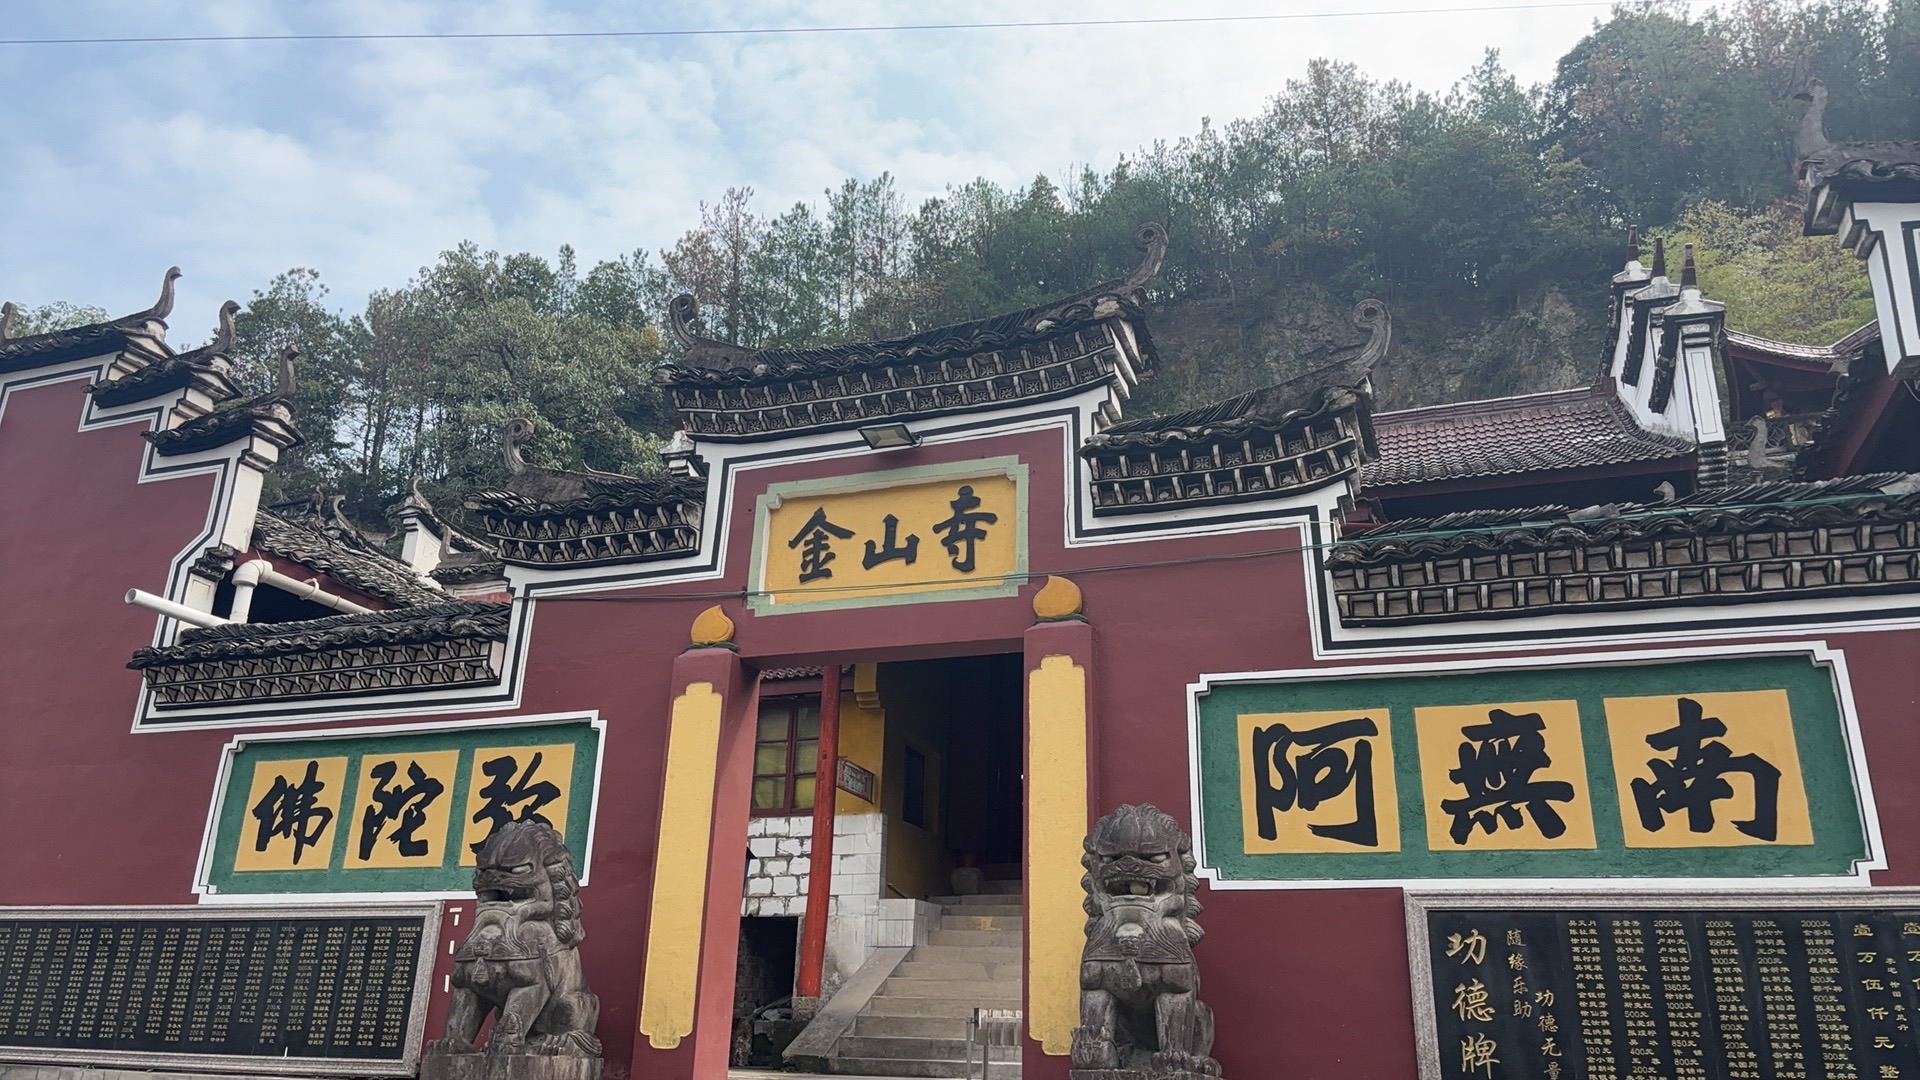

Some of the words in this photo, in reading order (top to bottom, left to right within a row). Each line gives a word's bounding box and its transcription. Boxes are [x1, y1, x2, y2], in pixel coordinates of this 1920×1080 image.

[788, 485, 998, 584] 金山寺
[1751, 920, 1777, 928] 300元
[1616, 955, 1642, 963] 680元
[1710, 957, 1739, 965] 1000元
[1757, 957, 1783, 965] 200元
[1506, 928, 1533, 1020] 随缘乐助
[1618, 973, 1644, 981] 600元
[1809, 976, 1836, 984] 800元
[1716, 995, 1742, 1003] 800元
[1812, 995, 1839, 1003] 600元
[1853, 923, 1901, 1079] 壹万伍仟元整
[1445, 929, 1501, 1080] 功德牌
[1666, 1002, 1695, 1010] 1000元
[1624, 1010, 1650, 1018] 500元
[1815, 1014, 1842, 1022] 500元
[1720, 1023, 1746, 1031] 600元
[1534, 989, 1563, 1080] 功德无量
[1671, 1039, 1698, 1047] 850元
[1629, 1048, 1655, 1056] 400元
[1822, 1053, 1849, 1061] 300元
[1674, 1058, 1700, 1066] 800元
[1632, 1066, 1658, 1074] 200元
